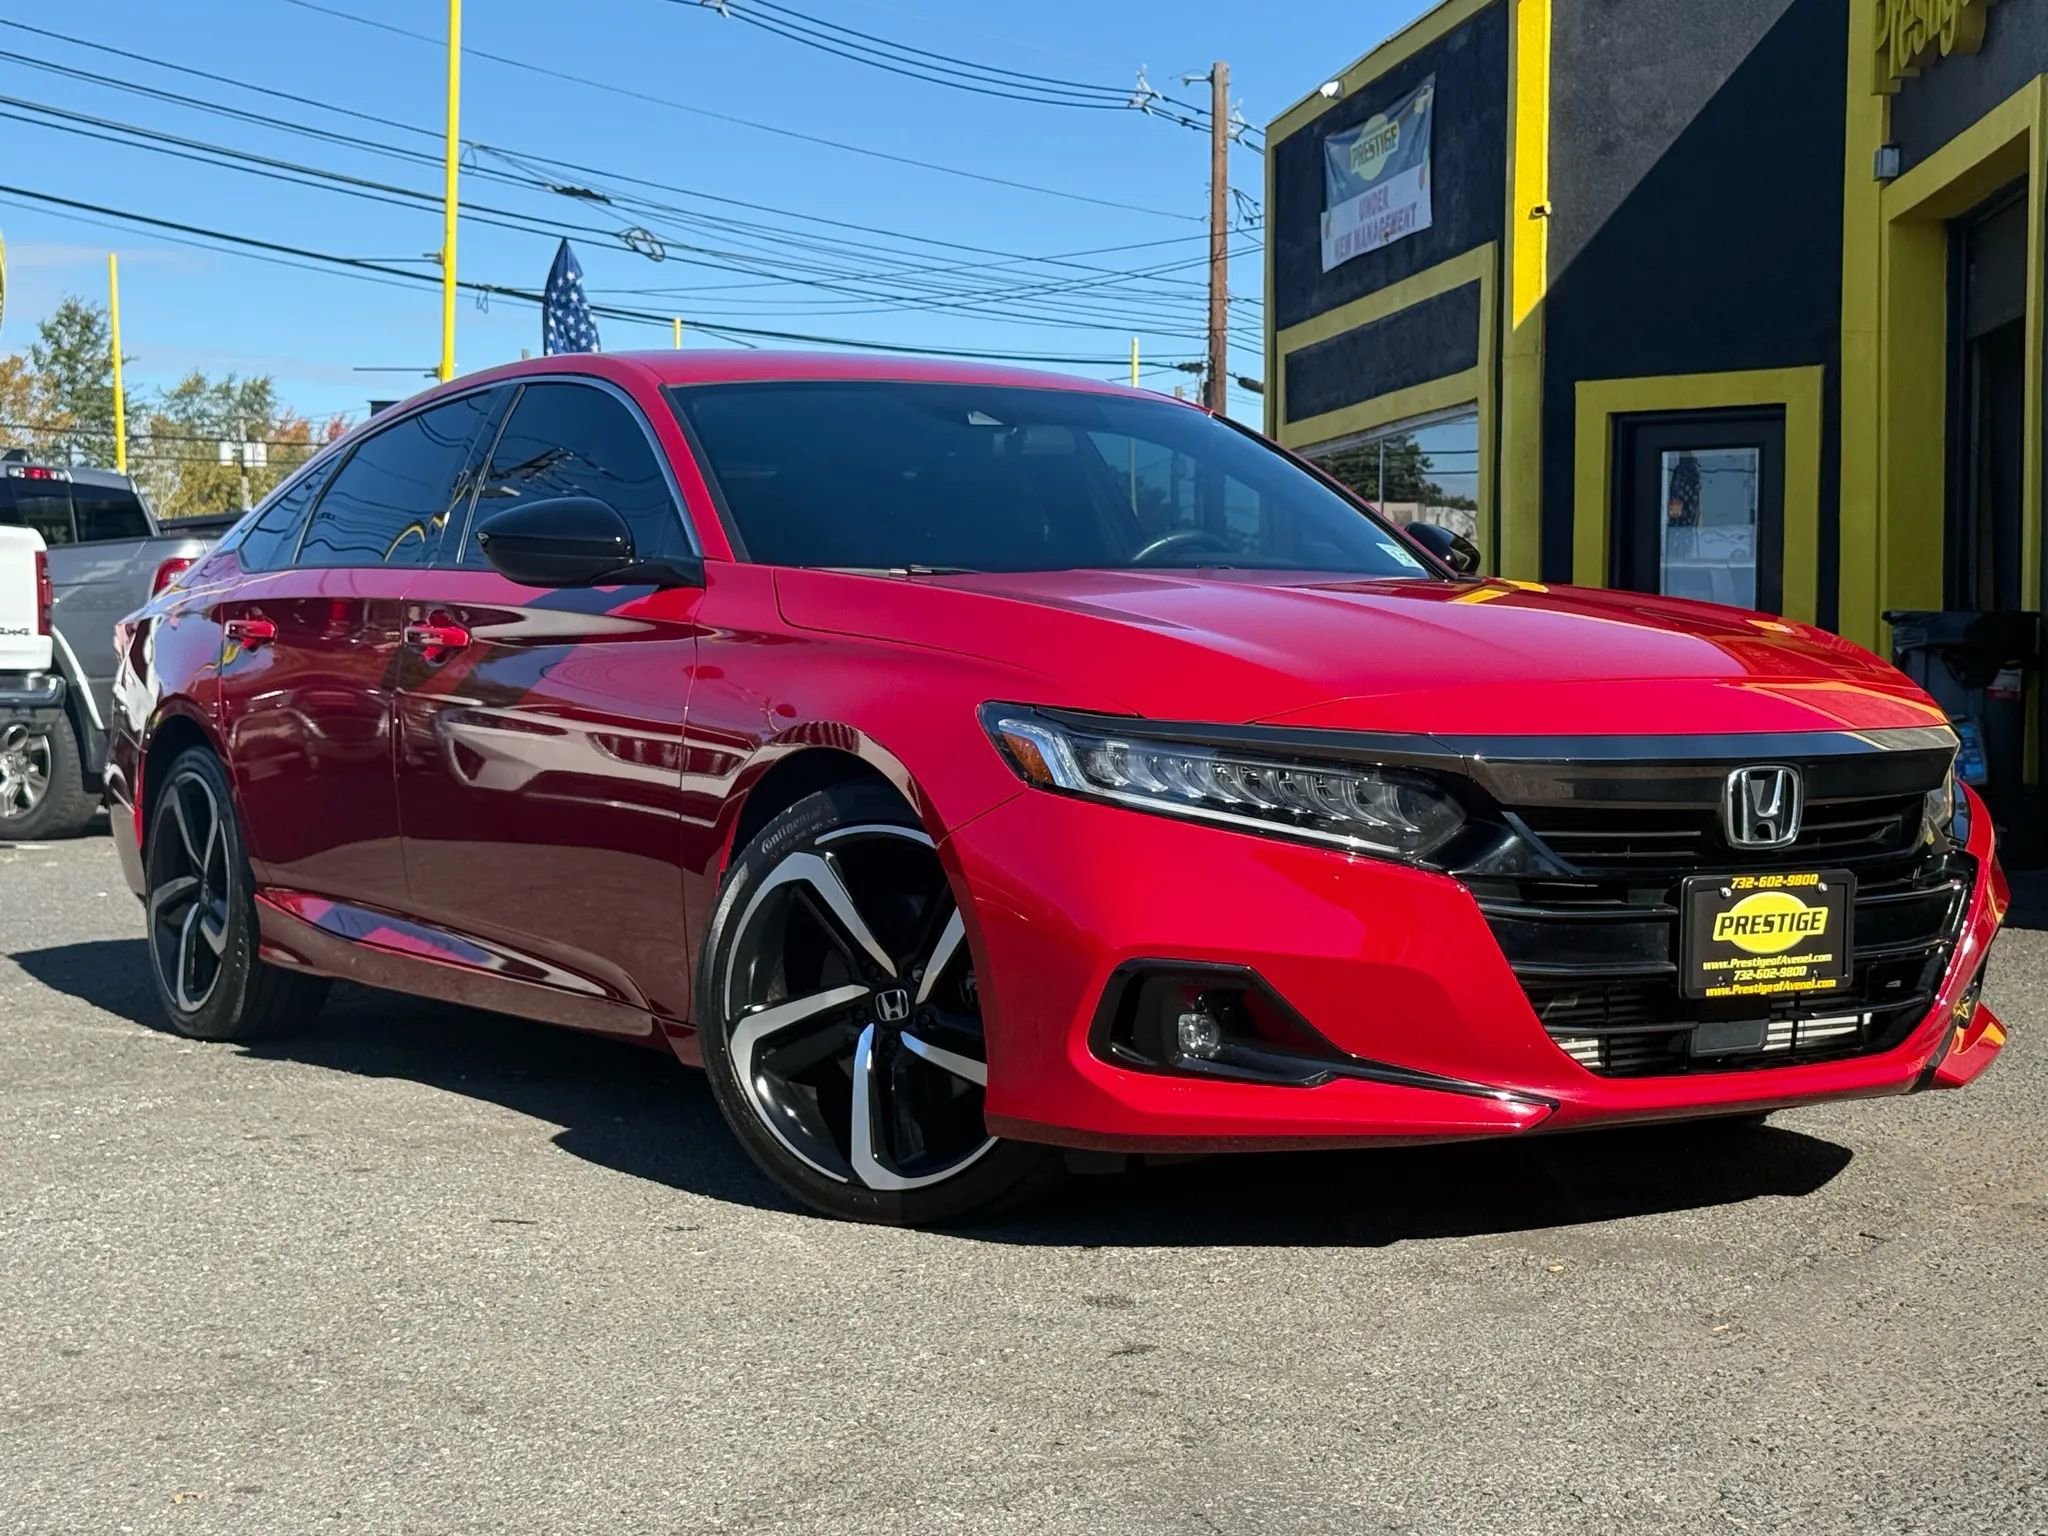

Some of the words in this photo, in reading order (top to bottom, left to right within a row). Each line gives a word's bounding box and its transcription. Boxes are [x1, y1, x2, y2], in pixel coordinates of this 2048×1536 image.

[1350, 122, 1398, 170] PRESTIGE
[1359, 185, 1389, 221] UNDER
[1334, 232, 1353, 262] NEW
[1353, 202, 1417, 253] MANAGEMENT
[1730, 873, 1819, 889] 732-602-9800
[1718, 911, 1823, 937] PRESTIGE
[1702, 953, 1833, 970] www.PrestigeofAvenel.com
[1733, 966, 1808, 981] 732-602-9800
[1705, 978, 1837, 997] www.PrestigeofAvenel.com
